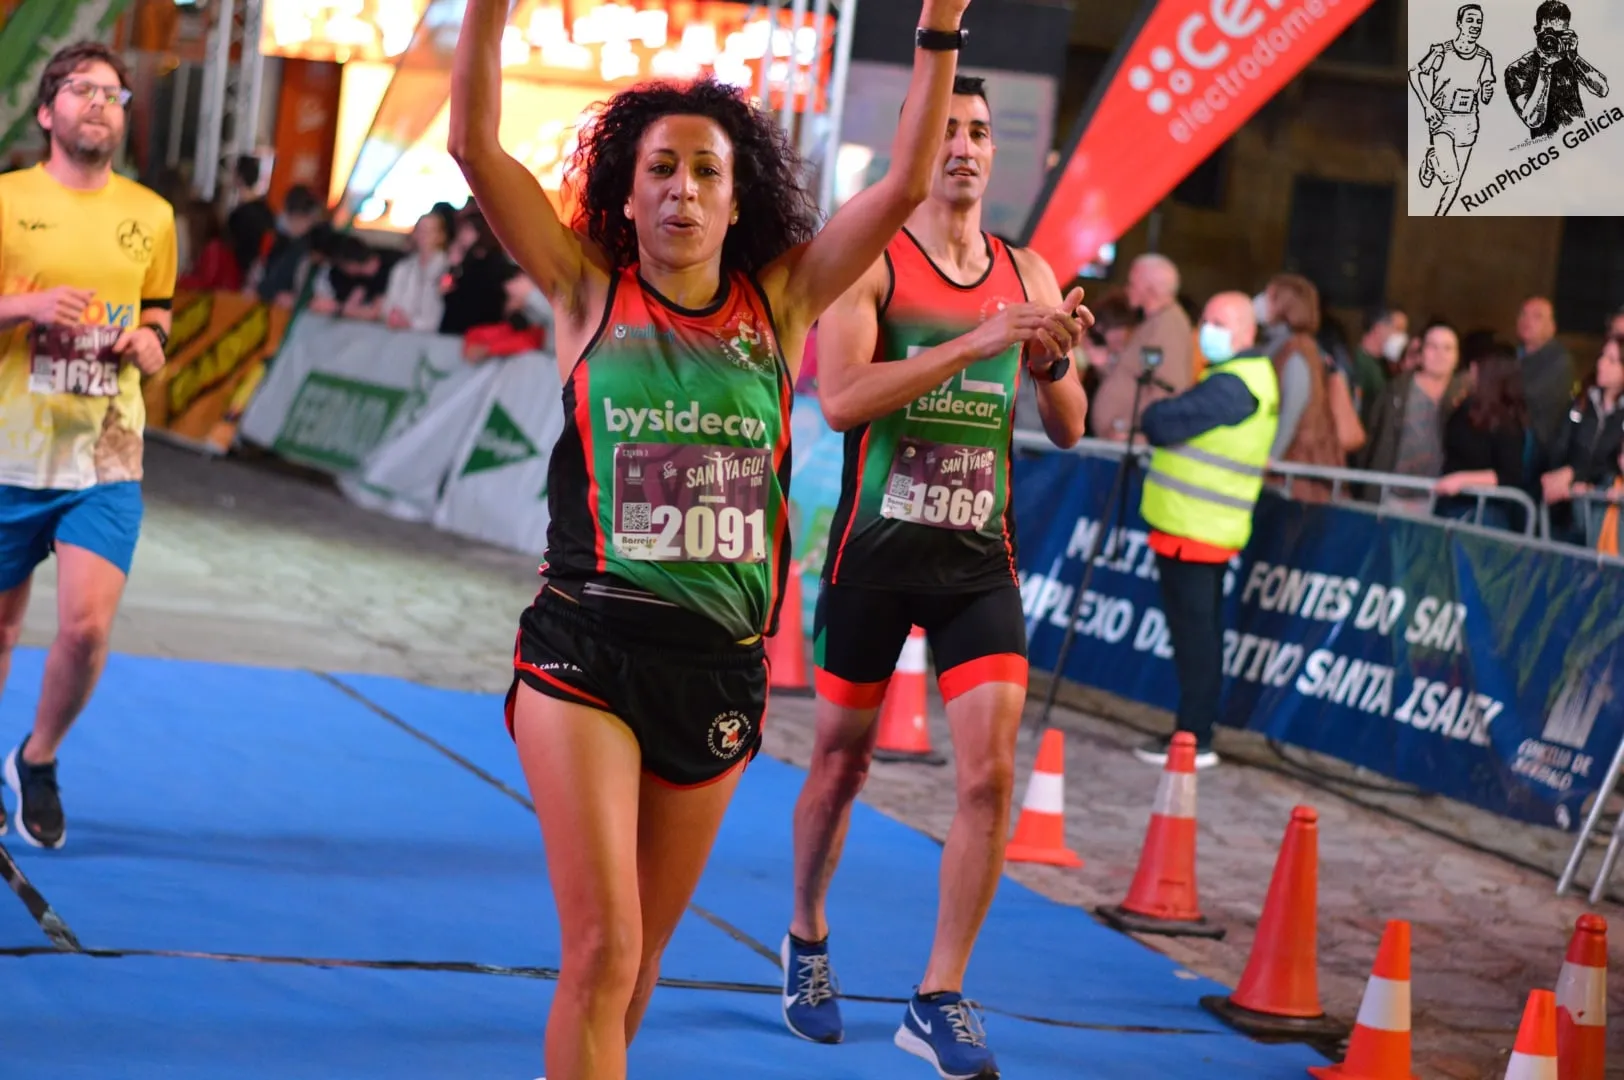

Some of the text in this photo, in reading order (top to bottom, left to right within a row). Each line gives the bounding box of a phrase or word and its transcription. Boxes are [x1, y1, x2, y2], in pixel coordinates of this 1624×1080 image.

[53, 357, 119, 397] 1625
[917, 389, 998, 418] sidecar
[651, 505, 766, 560] 2091
[909, 483, 995, 532] 1369
[1242, 560, 1360, 623] FONTES
[1354, 583, 1406, 637] DO
[1404, 596, 1468, 654] SAR
[1295, 648, 1396, 718] SANTA
[1393, 676, 1504, 747] ISABEL
